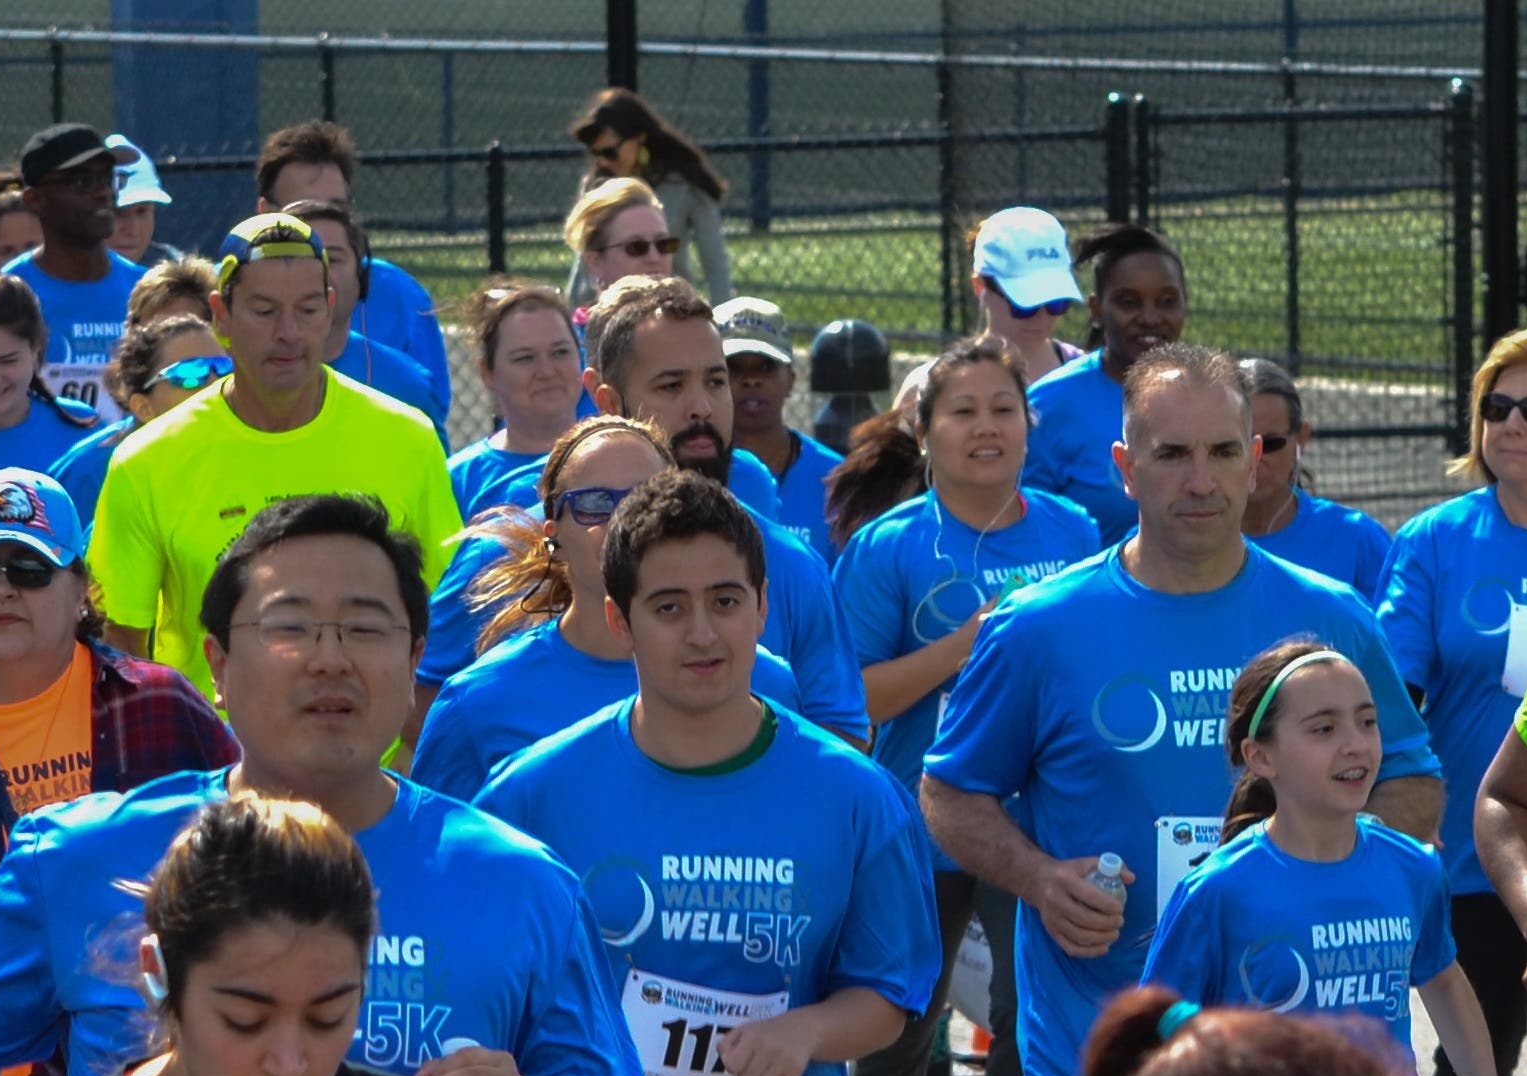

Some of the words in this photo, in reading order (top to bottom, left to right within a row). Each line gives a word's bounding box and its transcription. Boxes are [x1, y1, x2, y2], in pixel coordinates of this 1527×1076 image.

[1026, 246, 1060, 260] FILA
[73, 323, 126, 338] RUNNI
[1170, 667, 1241, 693] RUNN
[1, 751, 92, 787] RUNNIN
[661, 854, 794, 885] RUNNING
[661, 882, 793, 911] WALKING
[661, 910, 743, 944] WELL
[743, 912, 812, 967] 5K
[1311, 916, 1412, 949] RUNNING
[665, 987, 713, 1006] RUNNING
[714, 1000, 750, 1017] WELL
[1315, 973, 1385, 1008] WELL
[365, 1001, 452, 1067] 5K
